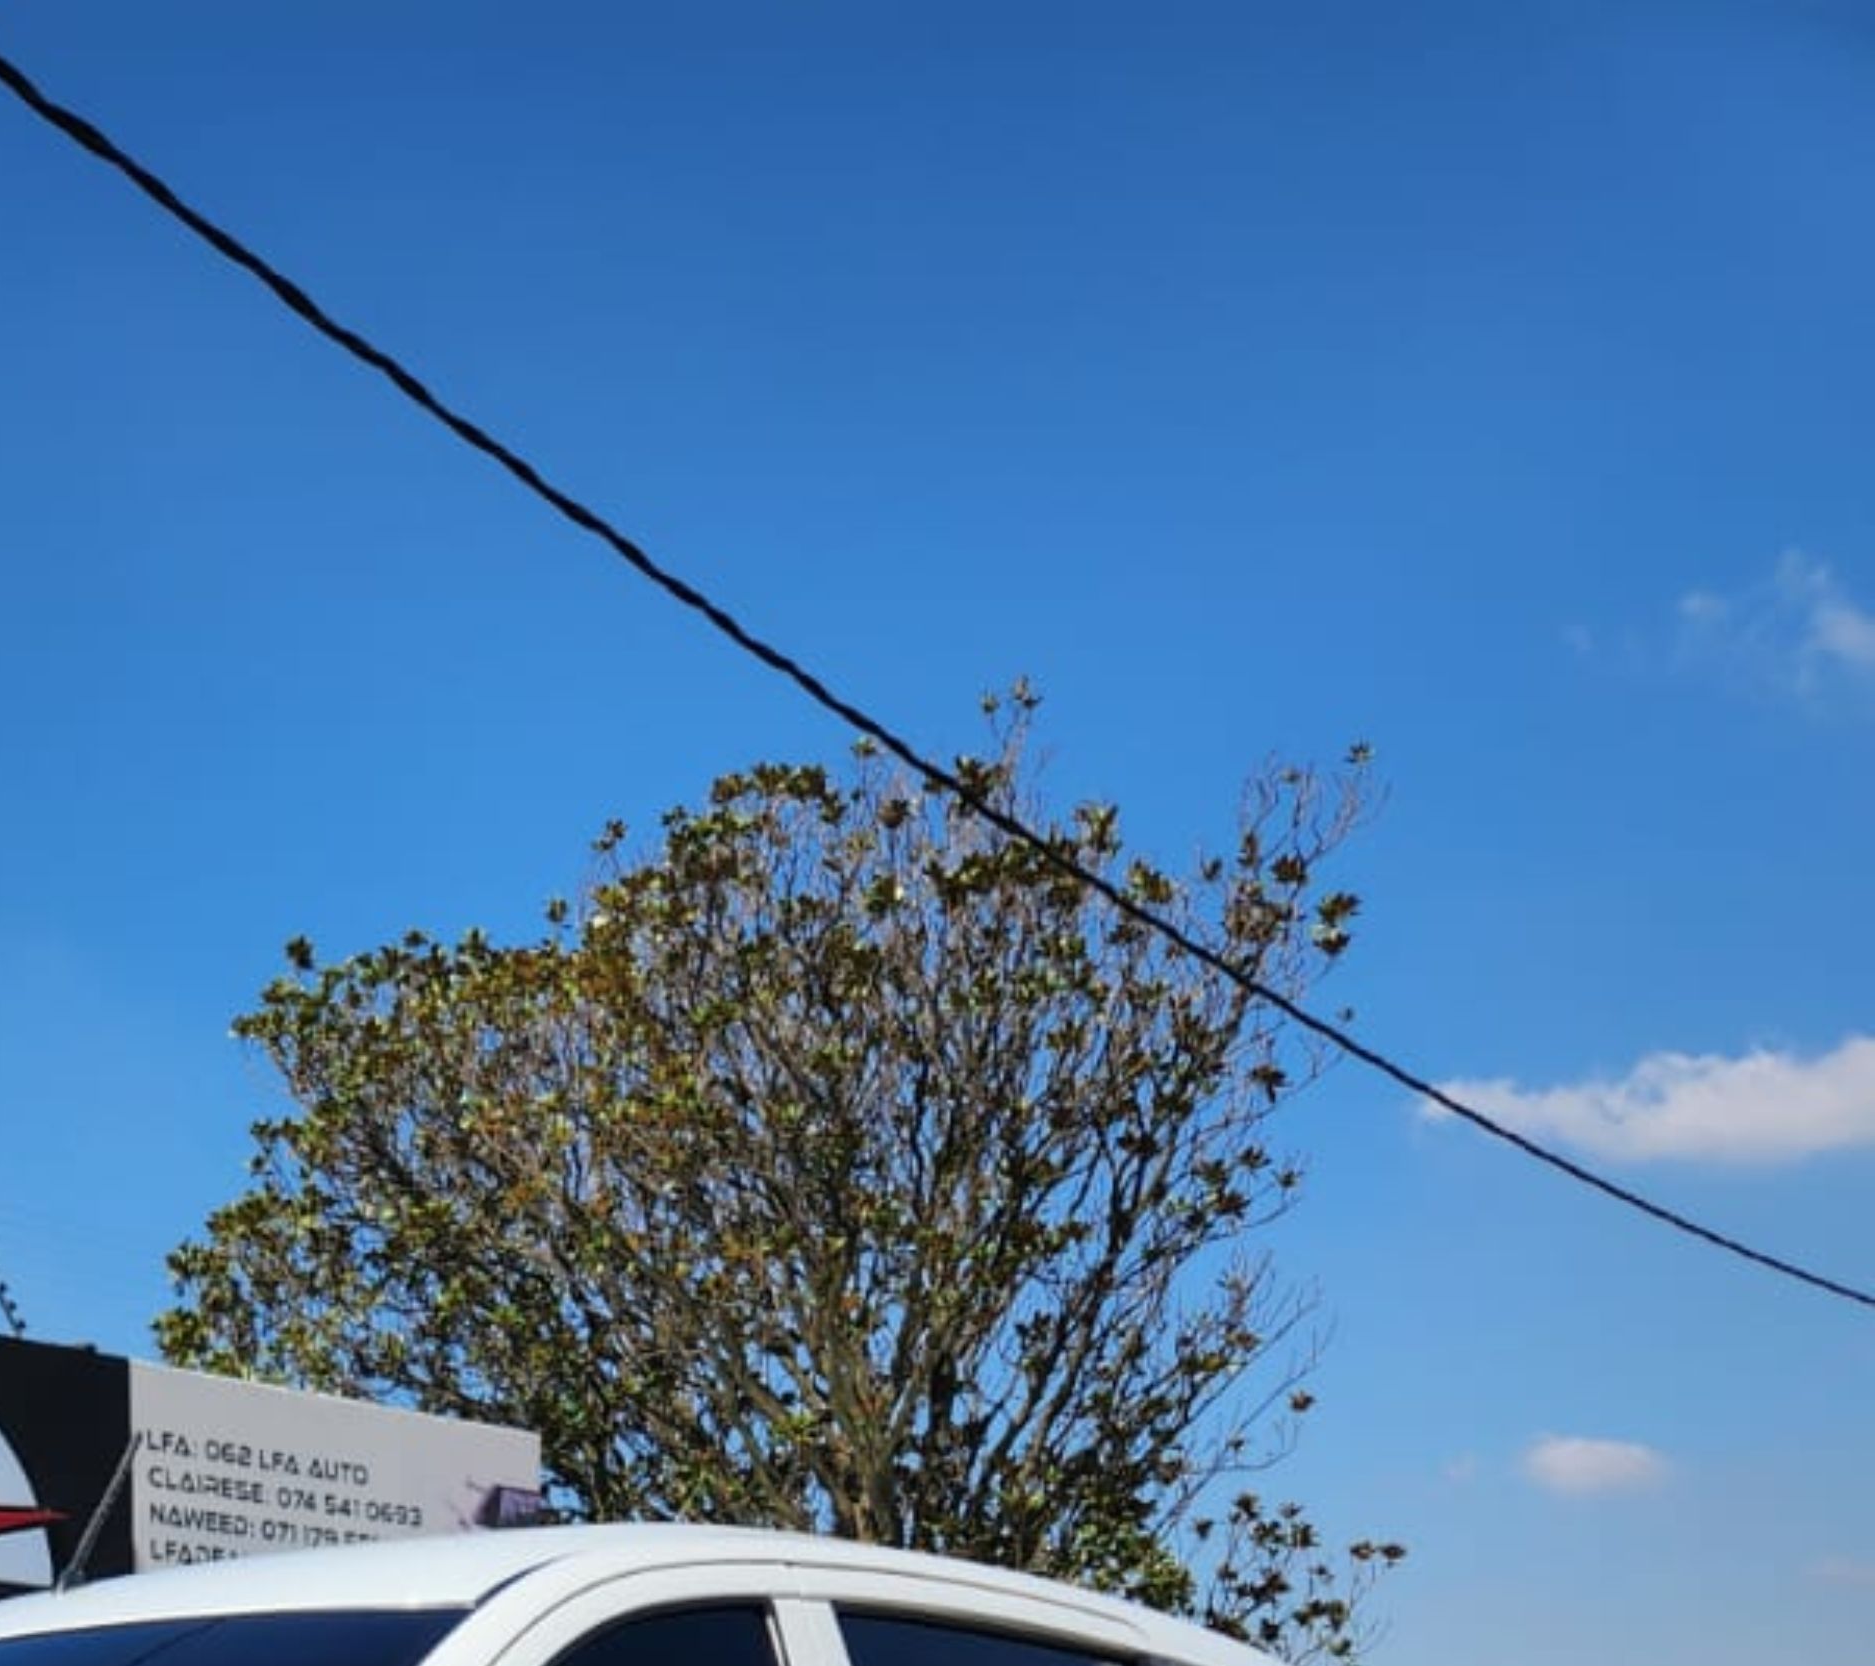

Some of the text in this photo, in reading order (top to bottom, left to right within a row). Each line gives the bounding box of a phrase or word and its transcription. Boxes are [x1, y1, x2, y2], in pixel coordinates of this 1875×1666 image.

[204, 1439, 252, 1468] 062
[258, 1448, 300, 1477] LFA
[307, 1457, 370, 1487] AUTO
[149, 1502, 256, 1539] NAWEED:
[260, 1519, 299, 1543] 071
[276, 1486, 318, 1512] 074
[324, 1494, 362, 1518] 541
